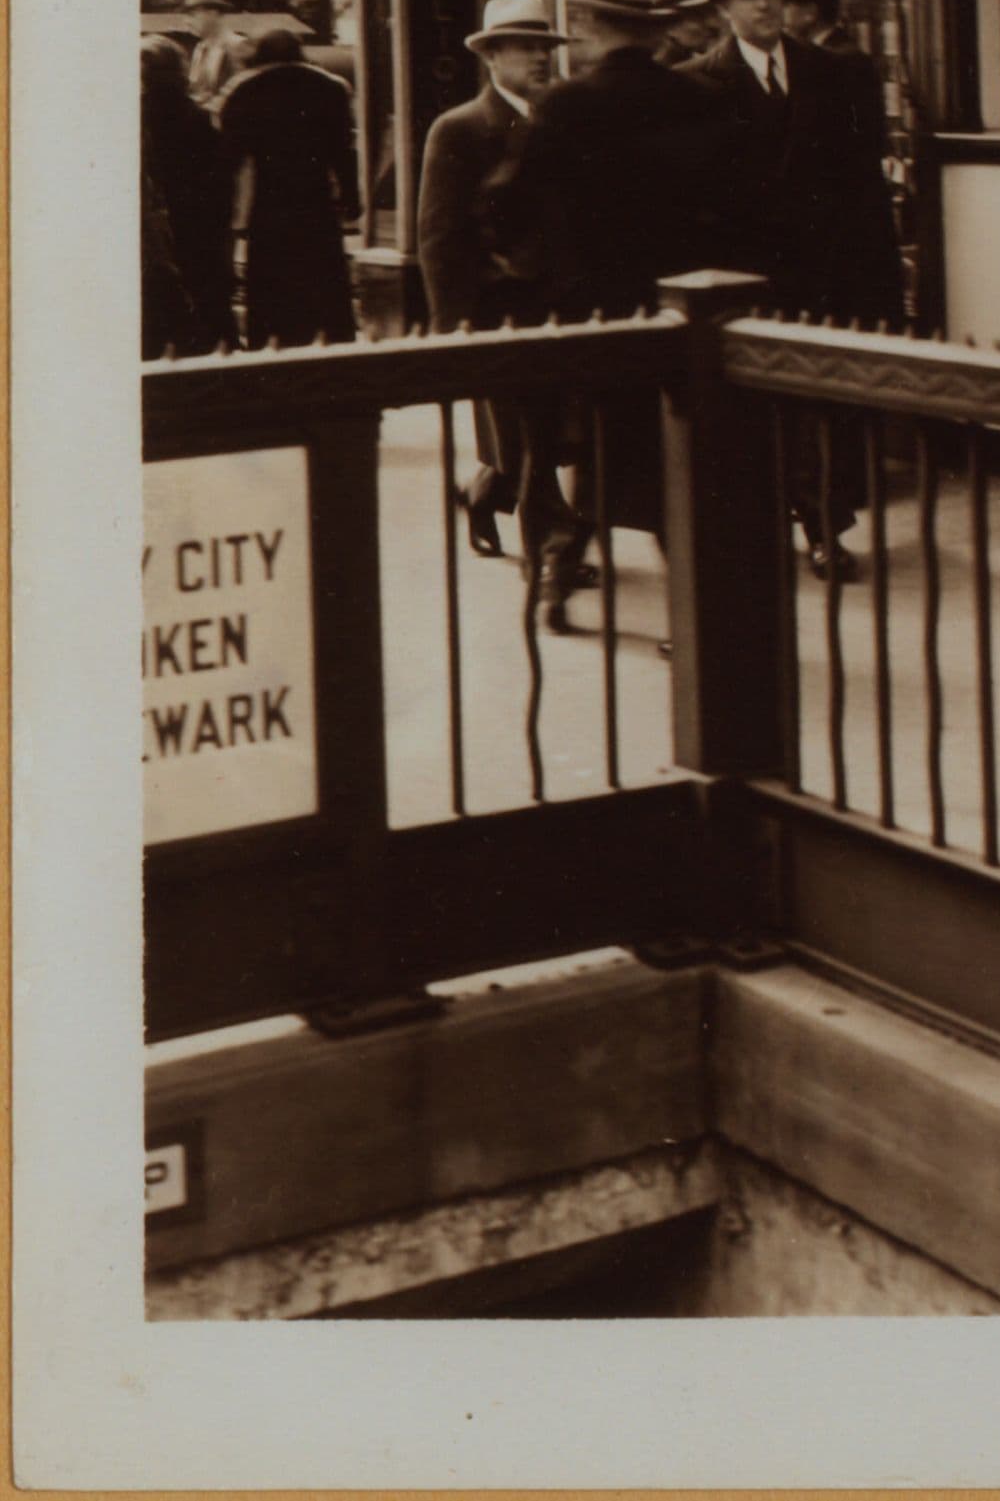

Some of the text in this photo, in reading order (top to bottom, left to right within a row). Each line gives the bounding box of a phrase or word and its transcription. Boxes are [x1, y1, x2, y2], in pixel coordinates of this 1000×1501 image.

[176, 528, 285, 593] CITY
[143, 613, 248, 680] KEN
[143, 685, 293, 762] WARK
